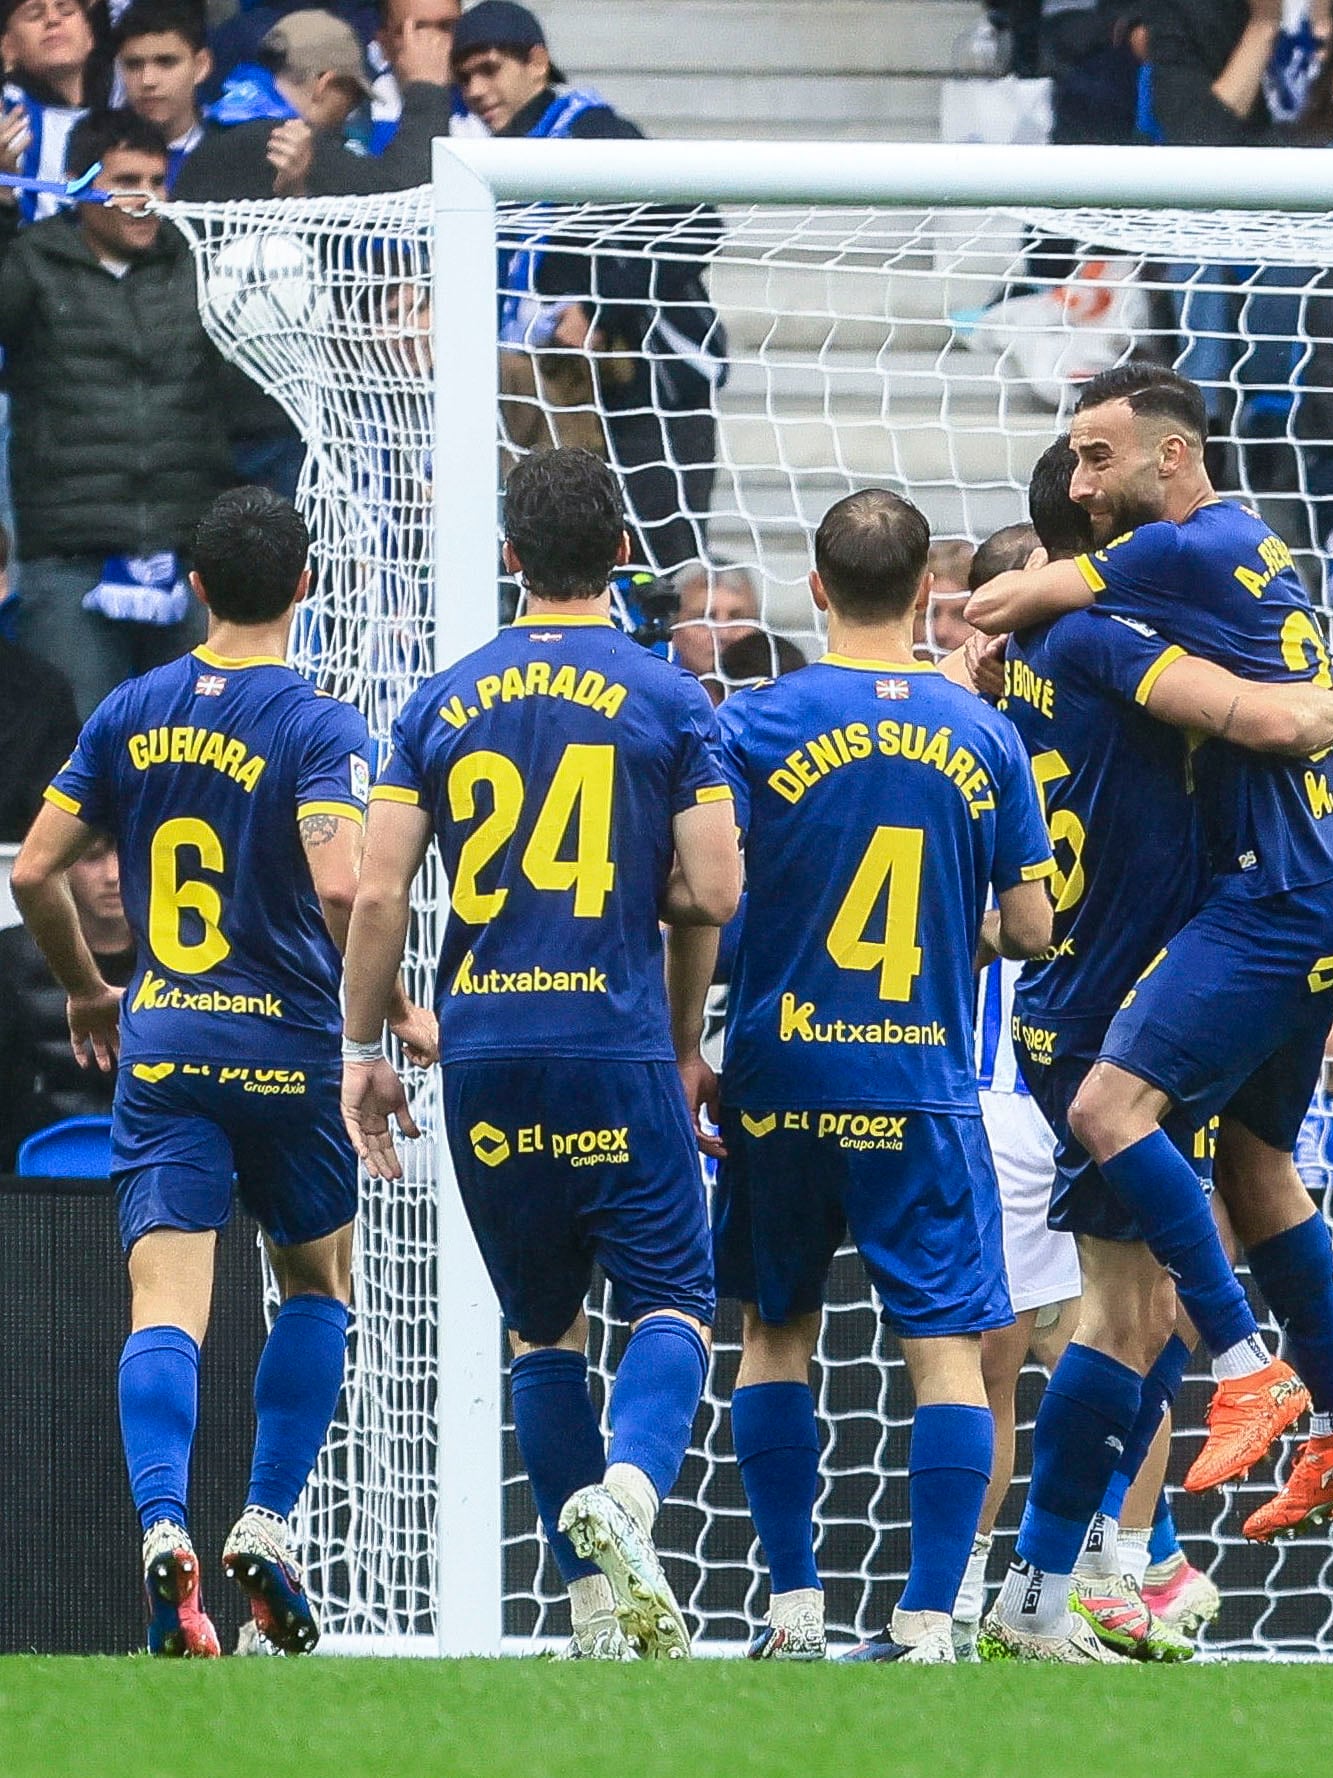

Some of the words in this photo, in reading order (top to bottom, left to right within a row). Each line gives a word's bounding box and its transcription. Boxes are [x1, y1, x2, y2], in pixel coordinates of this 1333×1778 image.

[476, 661, 628, 719] PARADA
[127, 726, 267, 793] GUEVARA
[767, 722, 873, 805] DENIS
[877, 719, 996, 820] SUÁREZ
[447, 743, 616, 925] 24
[150, 816, 231, 974] 6
[826, 825, 925, 1003] 4
[131, 970, 283, 1017] Kutxabank
[451, 951, 607, 996] Kutxabank
[779, 992, 946, 1047] Kutxabank
[243, 1081, 280, 1095] Grupo
[517, 1123, 544, 1154] El
[551, 1127, 629, 1158] proex
[818, 1112, 907, 1138] proex
[839, 1136, 875, 1152] Grupo
[875, 1138, 903, 1151] Axia
[570, 1153, 606, 1168] Grupo
